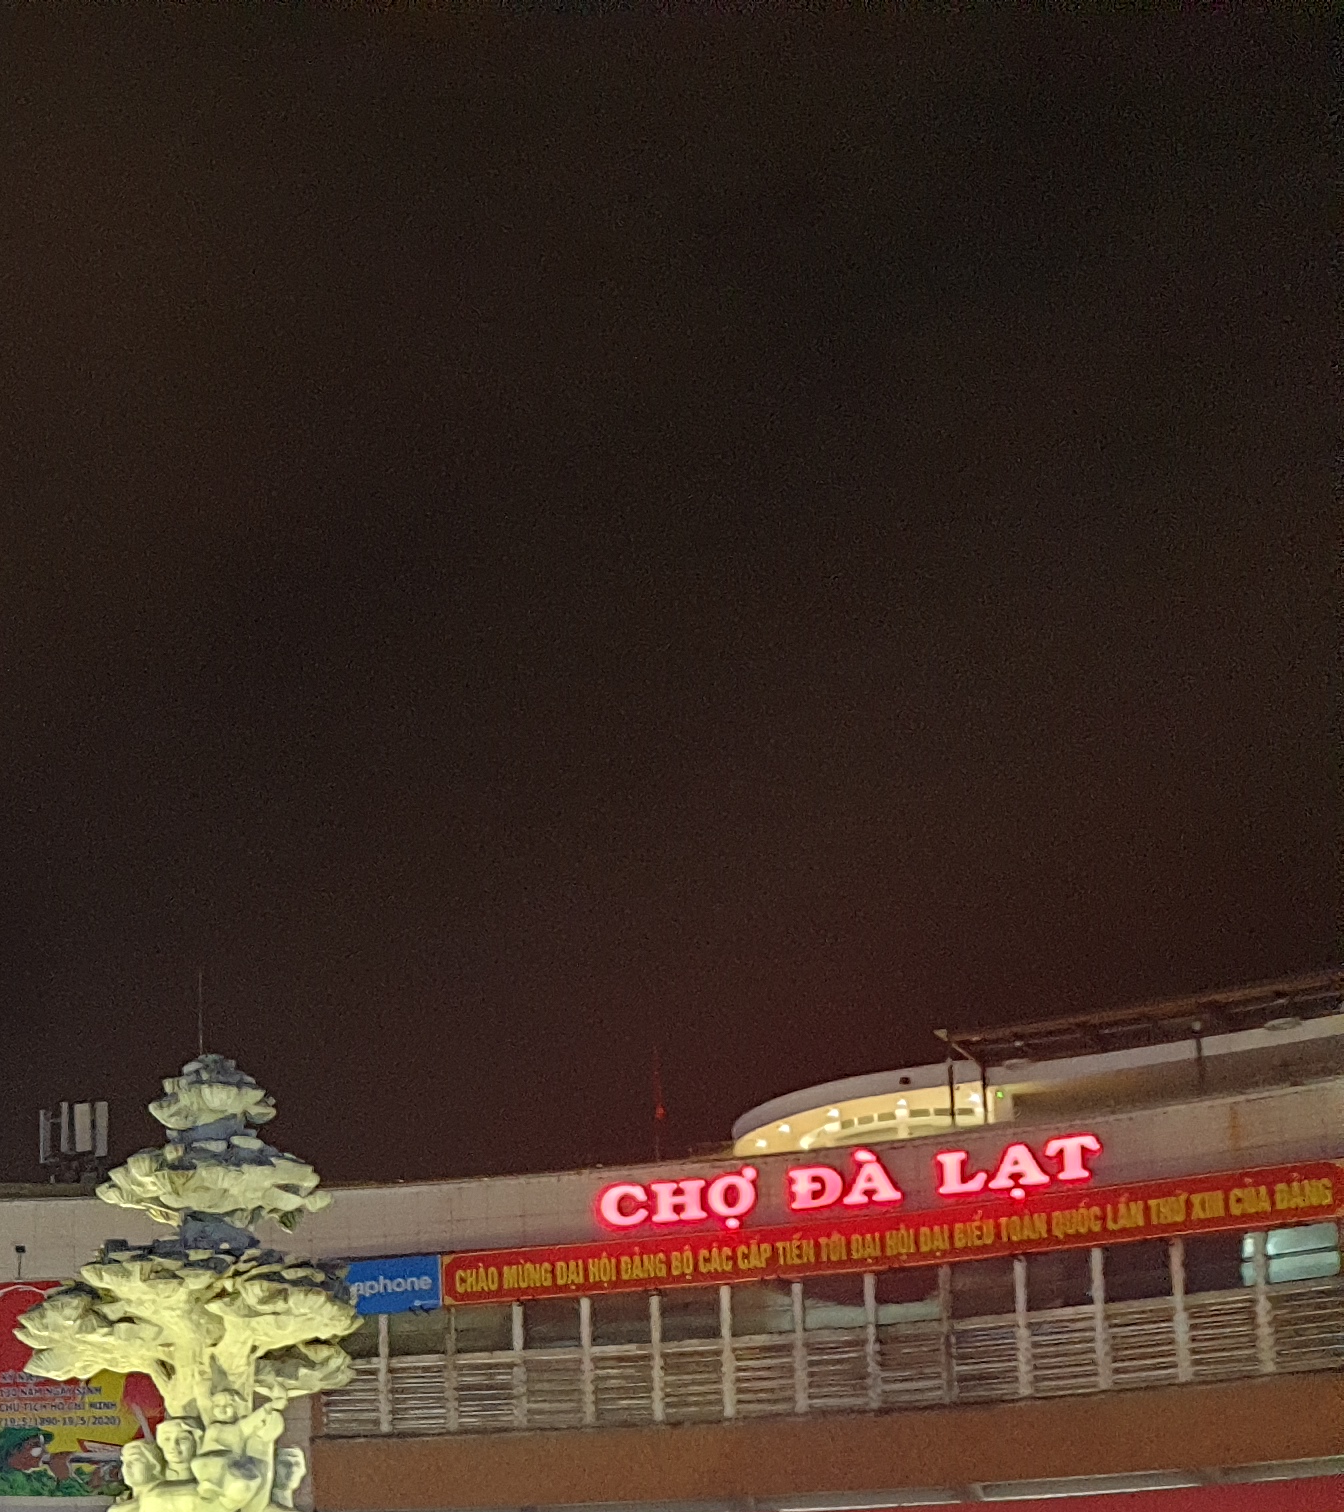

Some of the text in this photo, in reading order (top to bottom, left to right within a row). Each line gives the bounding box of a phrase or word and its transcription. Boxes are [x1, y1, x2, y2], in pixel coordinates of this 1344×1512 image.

[600, 1136, 1102, 1229] CHỢ ĐÀ LẠT
[353, 1275, 432, 1297] aphone
[455, 1260, 499, 1294] CHÀO
[503, 1255, 553, 1289] MỪNG
[555, 1259, 584, 1290] ĐẠI
[588, 1251, 617, 1287] HỘI
[620, 1246, 667, 1280] ĐẢNG
[671, 1243, 695, 1280] BỘ
[698, 1241, 733, 1273] CÁC
[737, 1234, 773, 1270] CẤP
